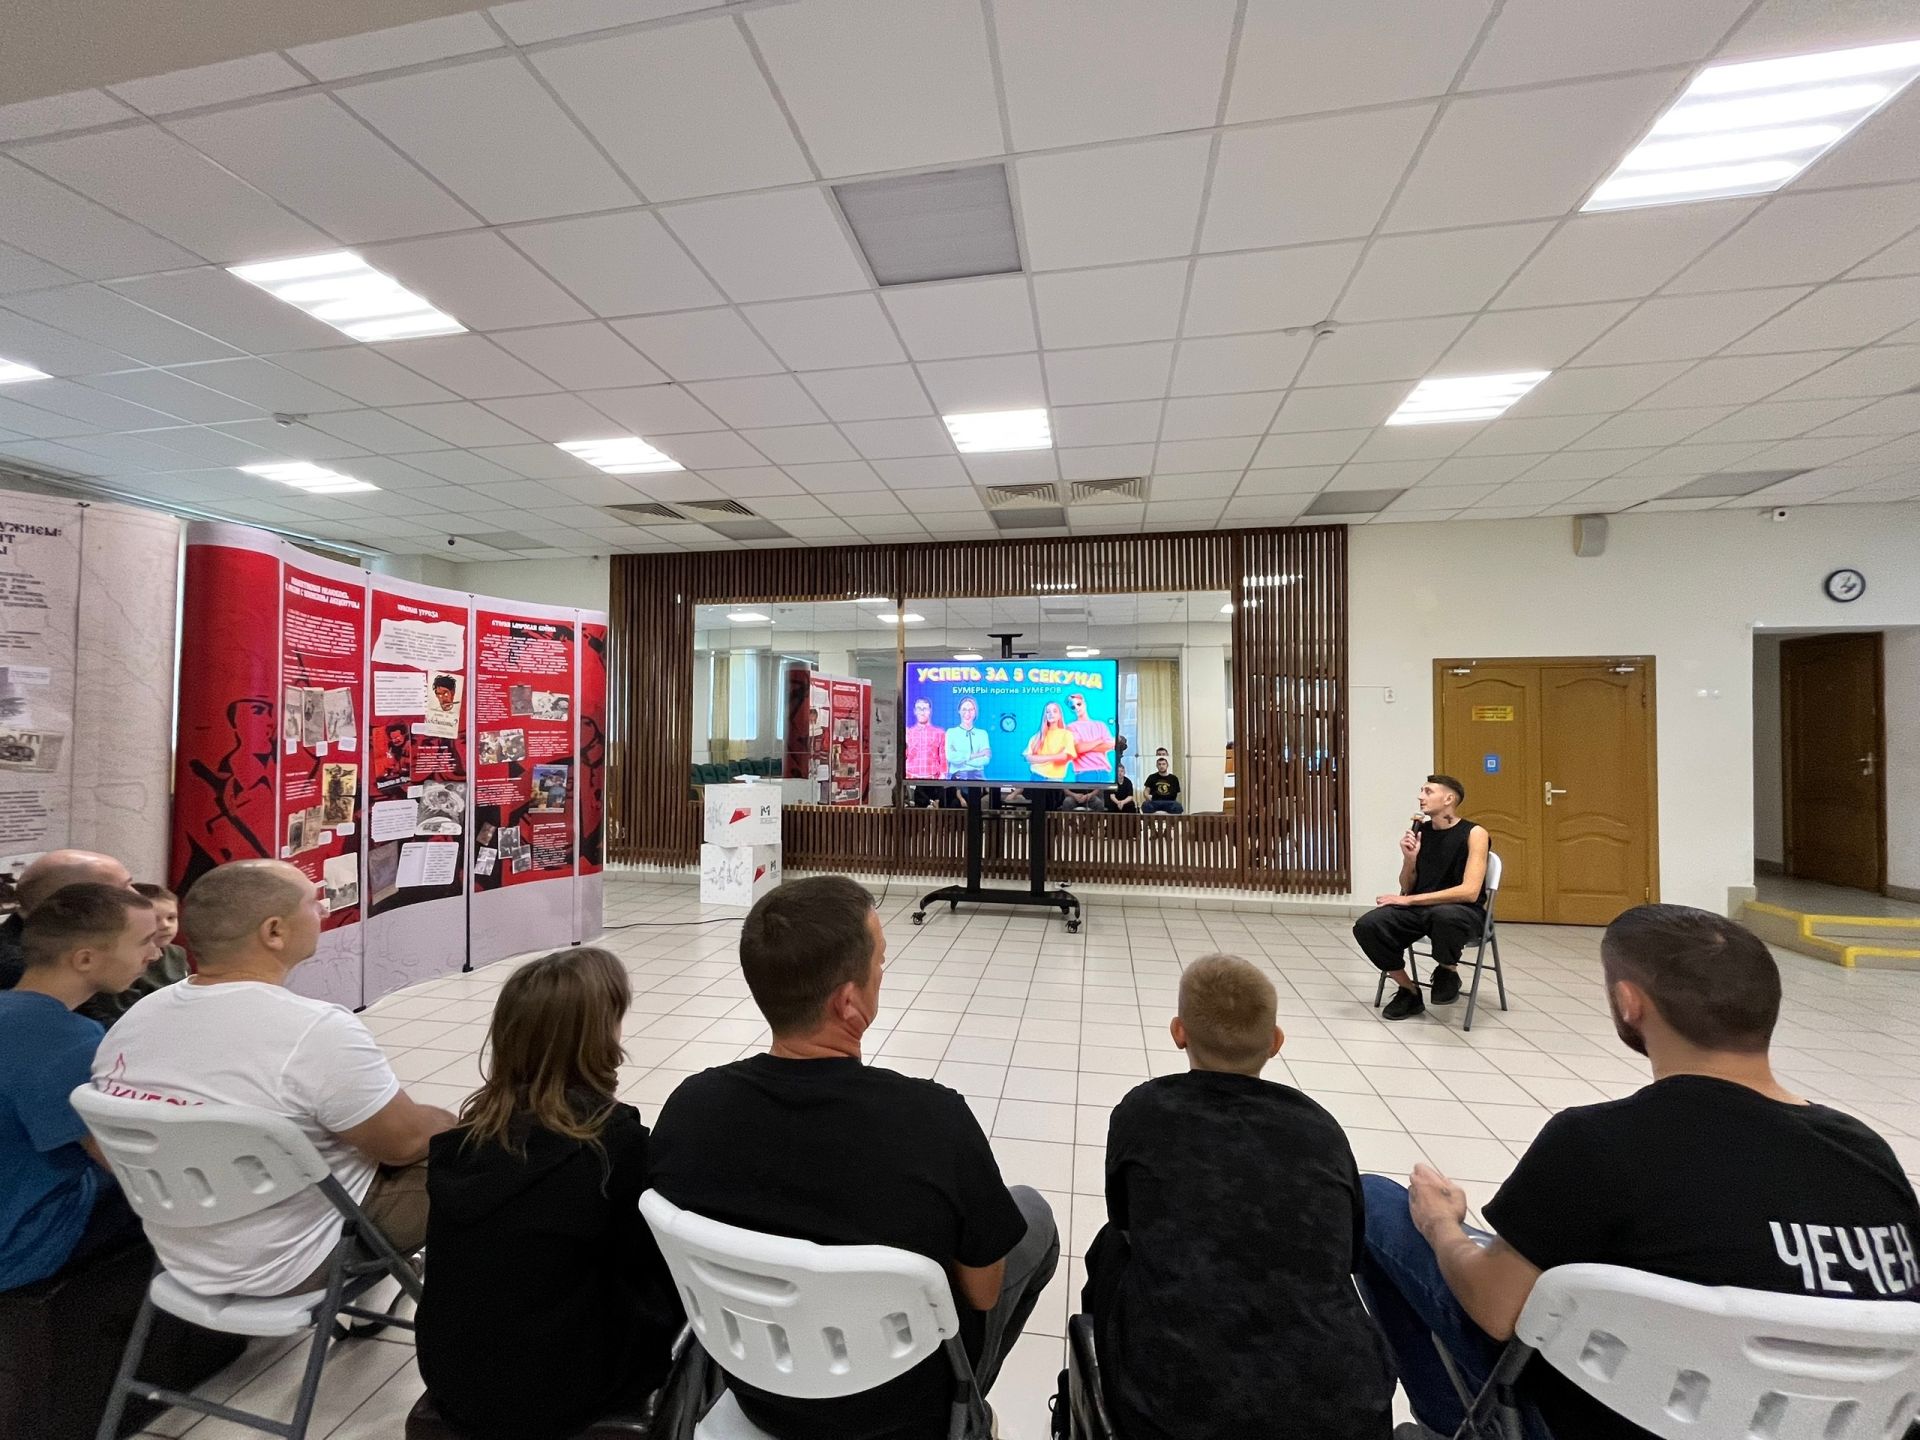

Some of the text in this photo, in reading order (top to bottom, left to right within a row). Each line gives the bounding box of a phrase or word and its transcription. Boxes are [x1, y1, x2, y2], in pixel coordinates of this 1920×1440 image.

[917, 667, 1103, 689] УСПЕТЬ ЗА 5 СЕКУНД
[990, 687, 1019, 695] против
[1022, 686, 1062, 694] ЗУМЕРОВ
[1768, 1221, 1920, 1294] ЧЕЧЕН
